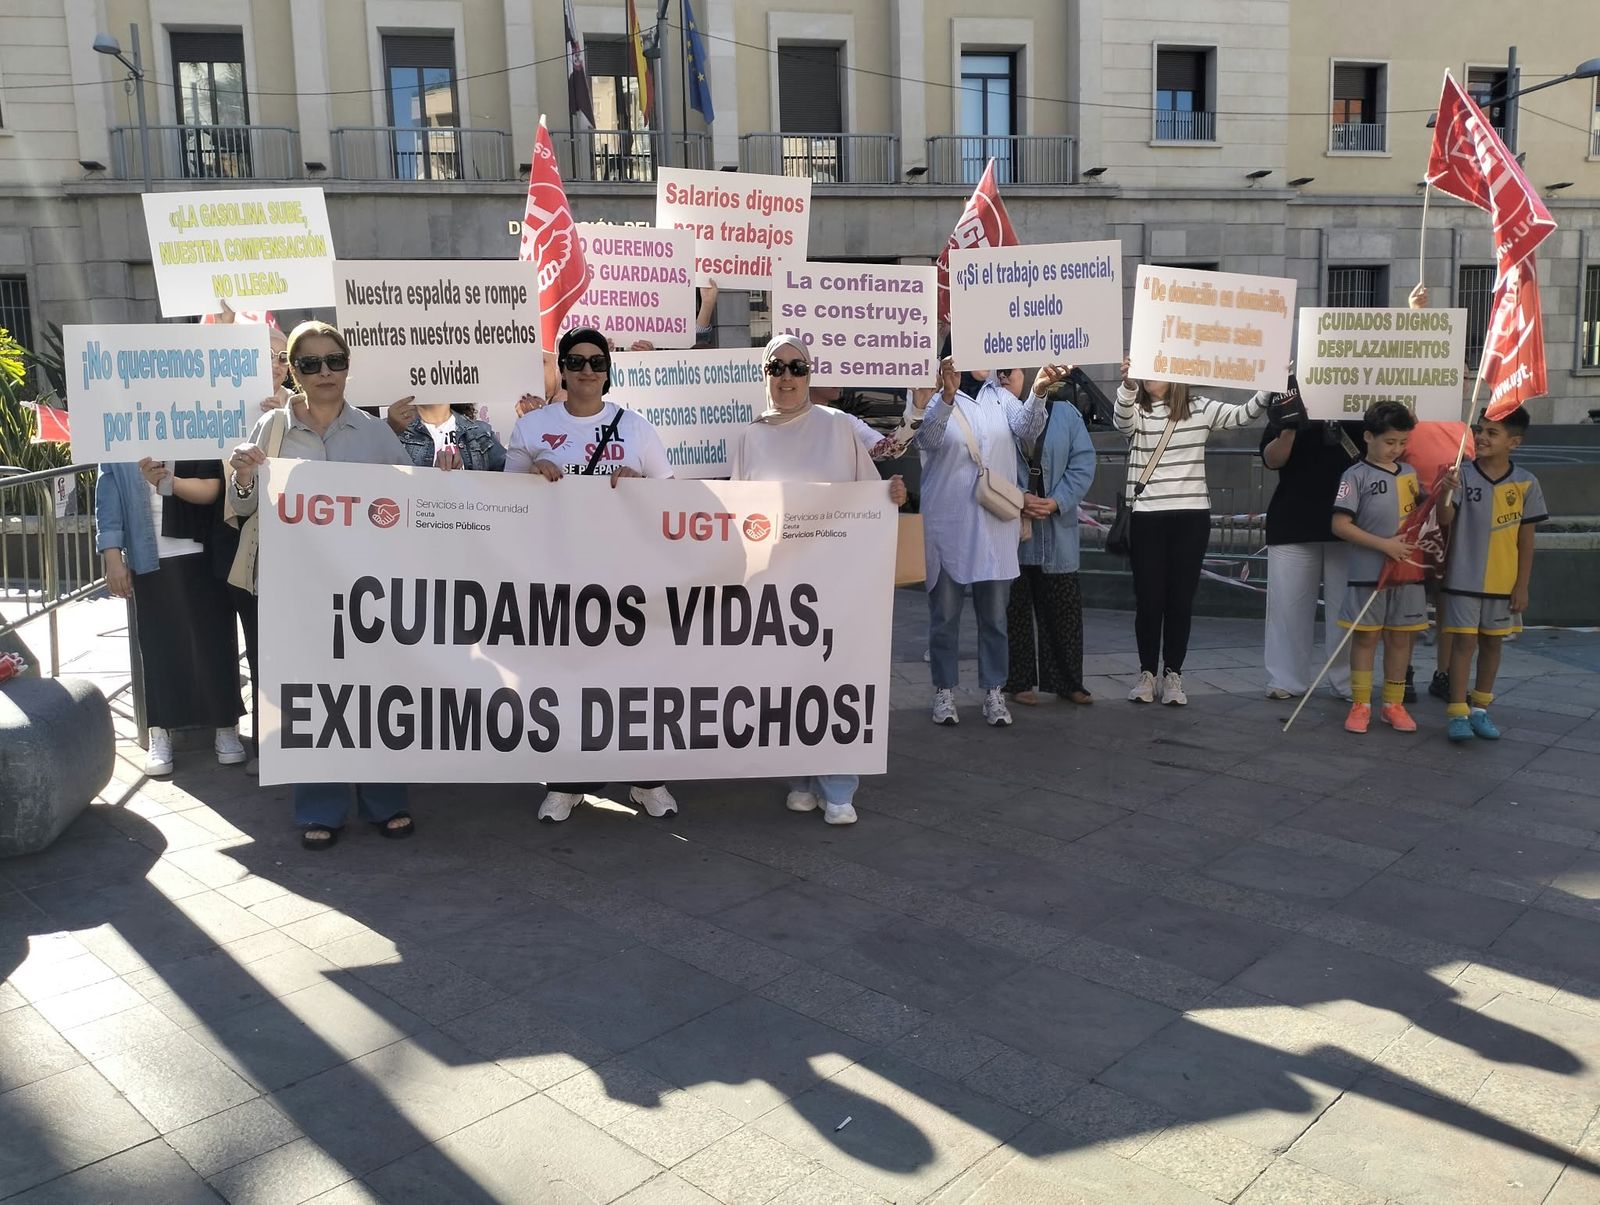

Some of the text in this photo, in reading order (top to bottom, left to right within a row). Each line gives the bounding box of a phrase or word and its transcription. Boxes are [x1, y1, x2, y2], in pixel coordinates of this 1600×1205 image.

[666, 182, 804, 216] Salarios dignos
[201, 202, 266, 227] GASOLINA
[268, 200, 308, 228] SUBE,
[159, 230, 327, 265] NUESTRA COMPENSACIÓN
[593, 238, 673, 258] QUEREMOS
[721, 221, 793, 250] trabajos
[600, 264, 691, 288] GUARDADAS,
[786, 271, 924, 294] La confianza
[982, 262, 993, 285] el
[997, 260, 1039, 288] trabajo
[1043, 263, 1057, 281] es
[1061, 255, 1114, 282] esencial,
[212, 274, 233, 298] NO
[345, 279, 527, 311] Nuestra espalda se rompe
[579, 289, 659, 308] QUEREMOS
[782, 302, 928, 325] se construye,
[1009, 294, 1063, 318] el sueldo
[343, 319, 536, 346] mientras nuestros derechos
[562, 314, 687, 334] ORAS ABONADAS!
[1194, 320, 1231, 346] gastos
[1233, 323, 1263, 346] salen
[1318, 312, 1453, 335] ¡CUIDADOS DIGNOS,
[822, 332, 846, 347] se
[854, 331, 931, 349] cambia
[984, 327, 1089, 356] debe serlo igual!»
[1317, 340, 1450, 359] DESPLAZAMIENTOS
[82, 341, 259, 390] ¡No queremos pagar
[410, 360, 479, 386] se olvidan
[628, 361, 650, 387] más
[655, 360, 700, 386] cambios
[704, 359, 764, 384] constantes
[840, 359, 930, 376] semana!
[1154, 350, 1168, 373] de
[1170, 355, 1211, 378] nuestro
[1305, 367, 1459, 387] JUSTOS Y AUXILIARES
[103, 400, 247, 451] por ir a trabajar!
[647, 403, 697, 427] personas
[700, 398, 753, 424] necesitan
[666, 439, 727, 466] ontinuidad!
[1371, 480, 1387, 496] 20
[1467, 487, 1482, 502] 23
[278, 493, 361, 526] UGT
[415, 498, 529, 514] Servicios a la Comunidad
[784, 513, 819, 522] Servicios
[826, 511, 833, 520] la
[834, 510, 881, 520] Comunidad
[415, 520, 491, 531] Servicios Públicos
[662, 511, 736, 541] UGT
[782, 529, 847, 539] Servicios Públicos
[332, 575, 834, 663] ¡CUIDAMOS VIDAS,
[280, 683, 877, 752] EXIGIMOS DERECHOS!
